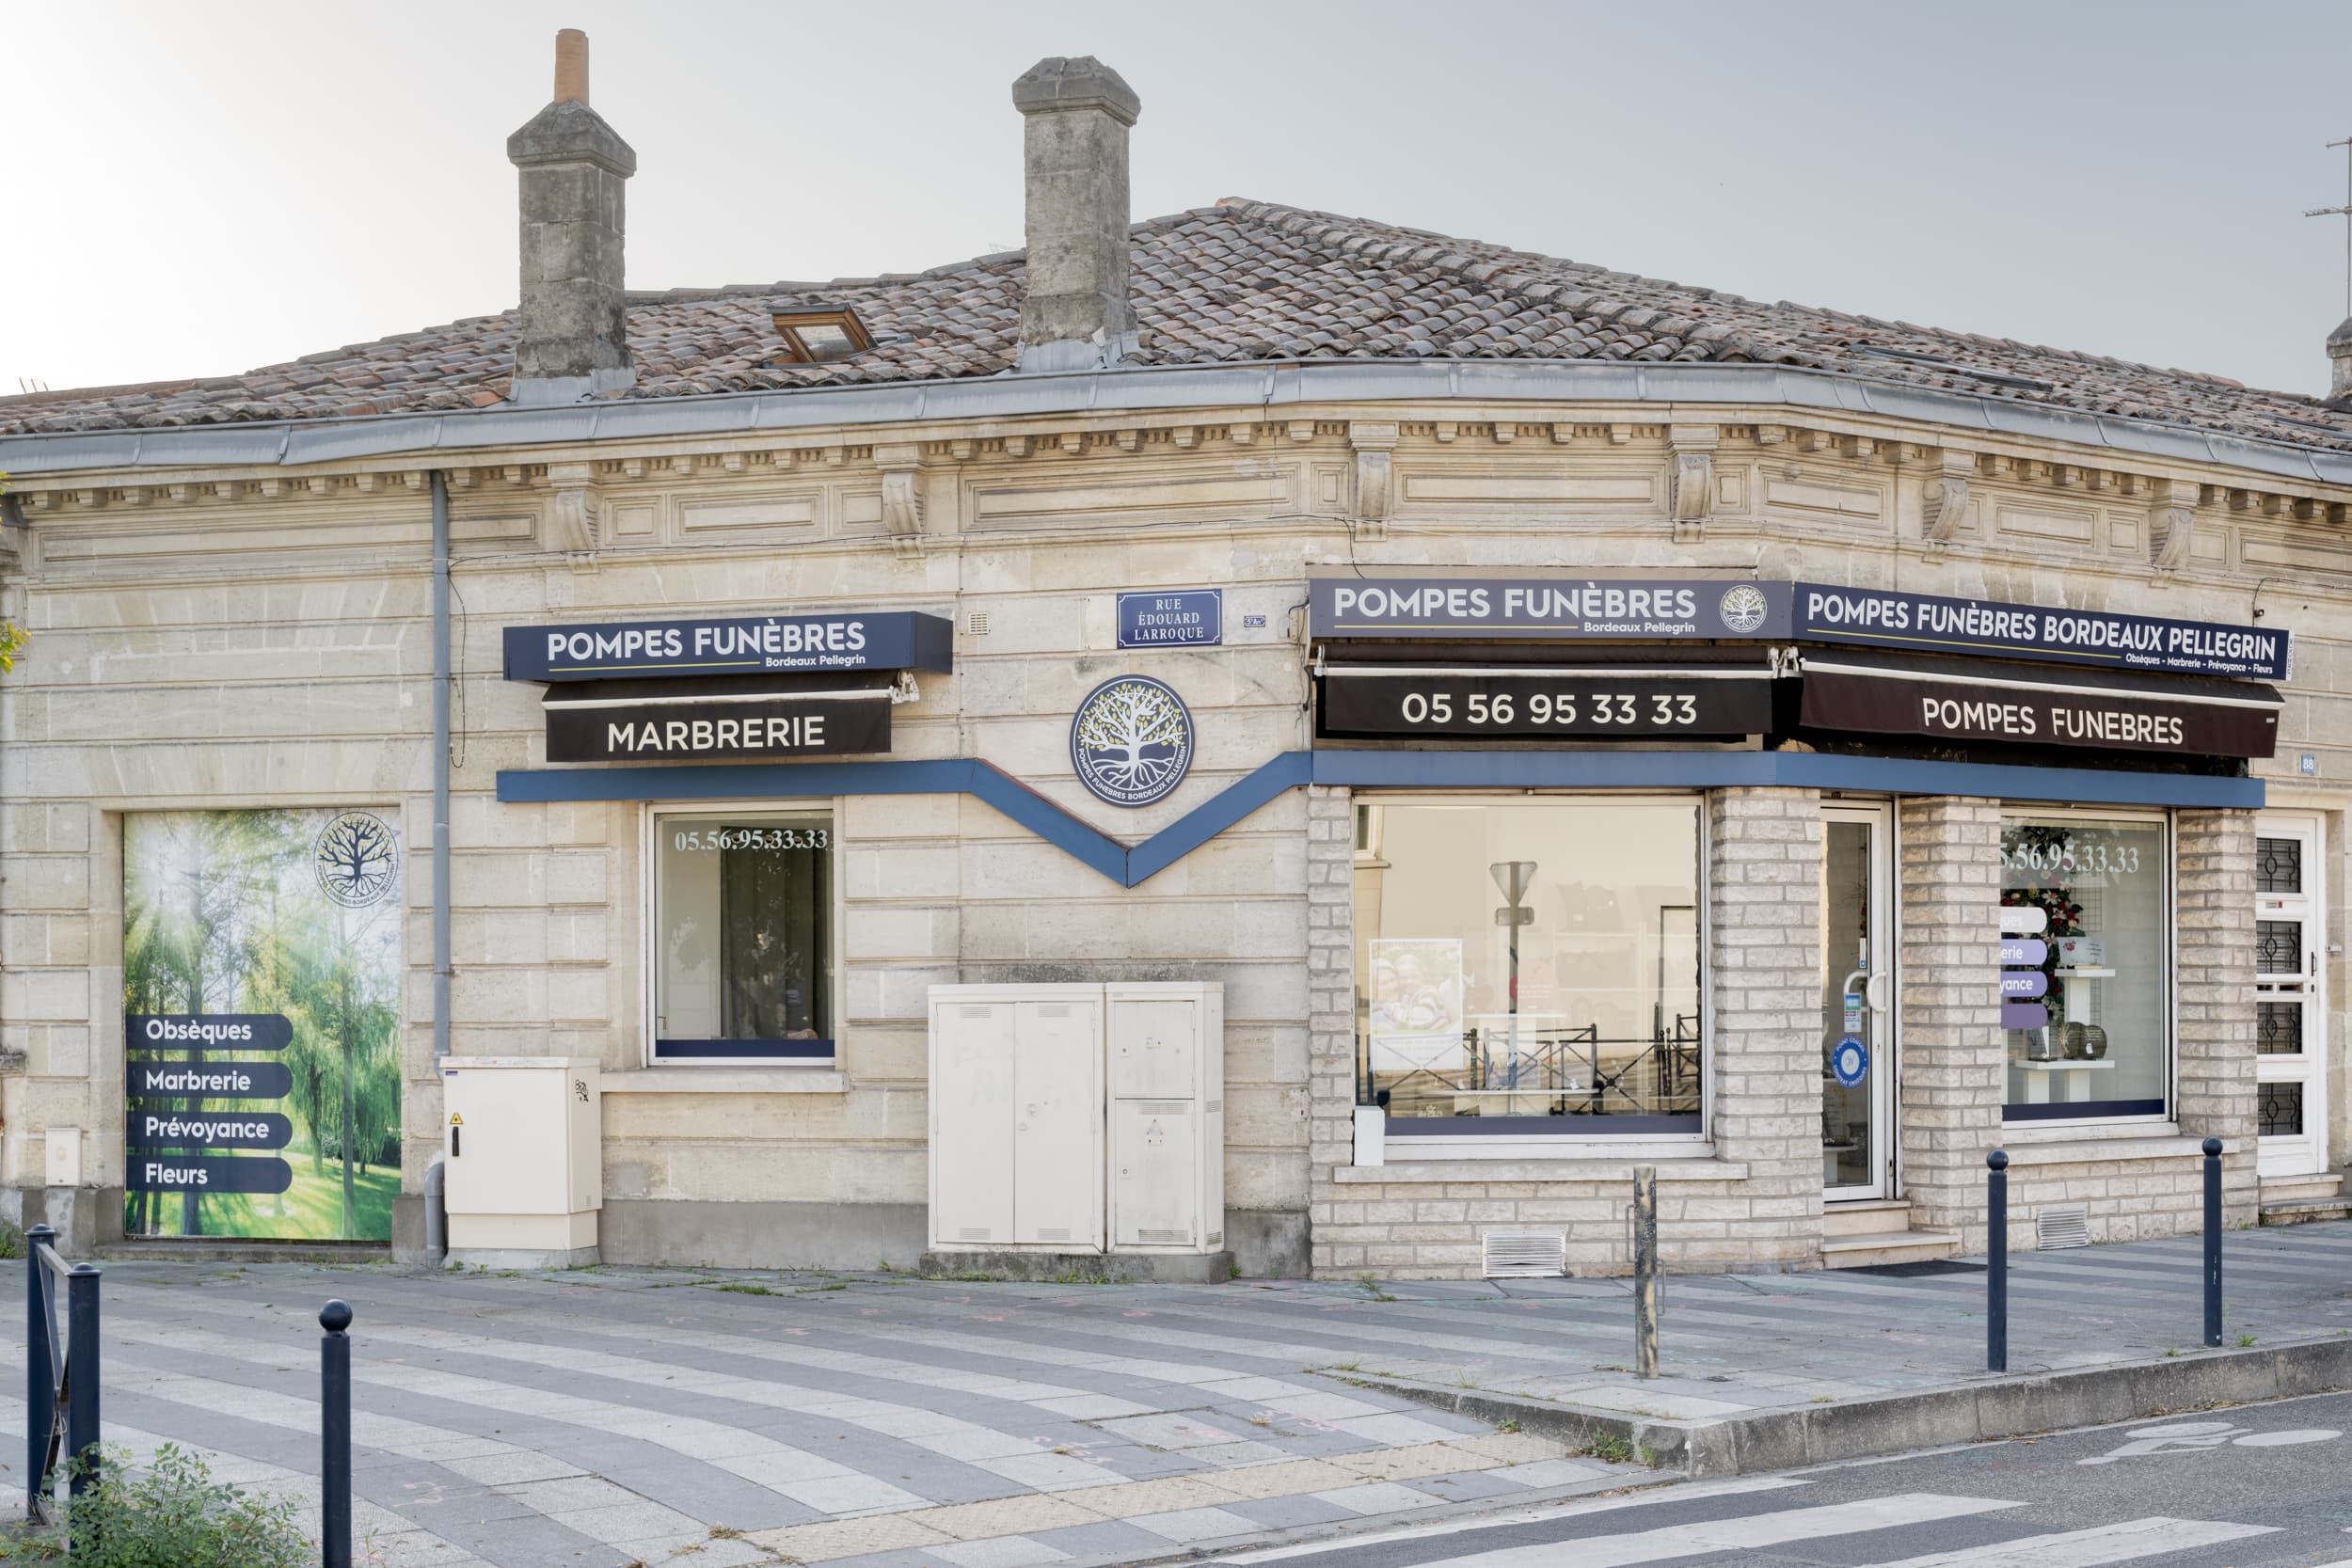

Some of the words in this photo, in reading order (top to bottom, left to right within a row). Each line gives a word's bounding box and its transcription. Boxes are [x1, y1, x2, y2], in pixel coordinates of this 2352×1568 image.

[1155, 599, 1182, 610] RUE
[1335, 587, 1490, 618] POMPES
[1504, 581, 1696, 618] FUNÈBRES
[1138, 610, 1200, 626] ÉDOUARD
[1584, 622, 1641, 633] Bordeaux
[1644, 621, 1696, 636] Pellegrin
[1808, 593, 1909, 629] POMPES
[1916, 602, 2036, 641] FUNÈBRES
[2043, 615, 2164, 652] BORDEAUX
[2169, 627, 2276, 661] PELLEGRIN
[548, 628, 683, 660] POMPES
[694, 618, 866, 656] FUNÈBRES
[1135, 626, 1204, 641] LARROQUE
[765, 657, 817, 667] Bordeaux
[819, 654, 866, 667] Pellegrin
[2125, 653, 2160, 666] Obsèques
[2167, 657, 2201, 669] Marbrerie
[2207, 660, 2247, 673] Prévoyance
[2252, 663, 2273, 674] Fleurs
[1402, 692, 1453, 723] 05
[1467, 693, 1515, 724] 56
[1529, 693, 1577, 724] 95
[1591, 694, 1637, 724] 33
[1651, 694, 1697, 724] 33
[1922, 697, 2037, 735] POMPES
[2051, 707, 2184, 745] FUNEBRES
[607, 716, 825, 752] MARBRERIE
[1077, 748, 1094, 779] POMPES
[1091, 776, 1126, 800] FUNEBRES
[1127, 782, 1167, 800] BORDEAUX
[1166, 745, 1187, 785] PELLEGRIN
[2302, 758, 2314, 769] 88
[2000, 842, 2139, 874] 5.56.95.33.33
[146, 1019, 252, 1045] Obsèques
[146, 1069, 251, 1091] Marbrerie
[146, 1117, 270, 1144] Prévoyance
[146, 1163, 208, 1185] Fleurs
